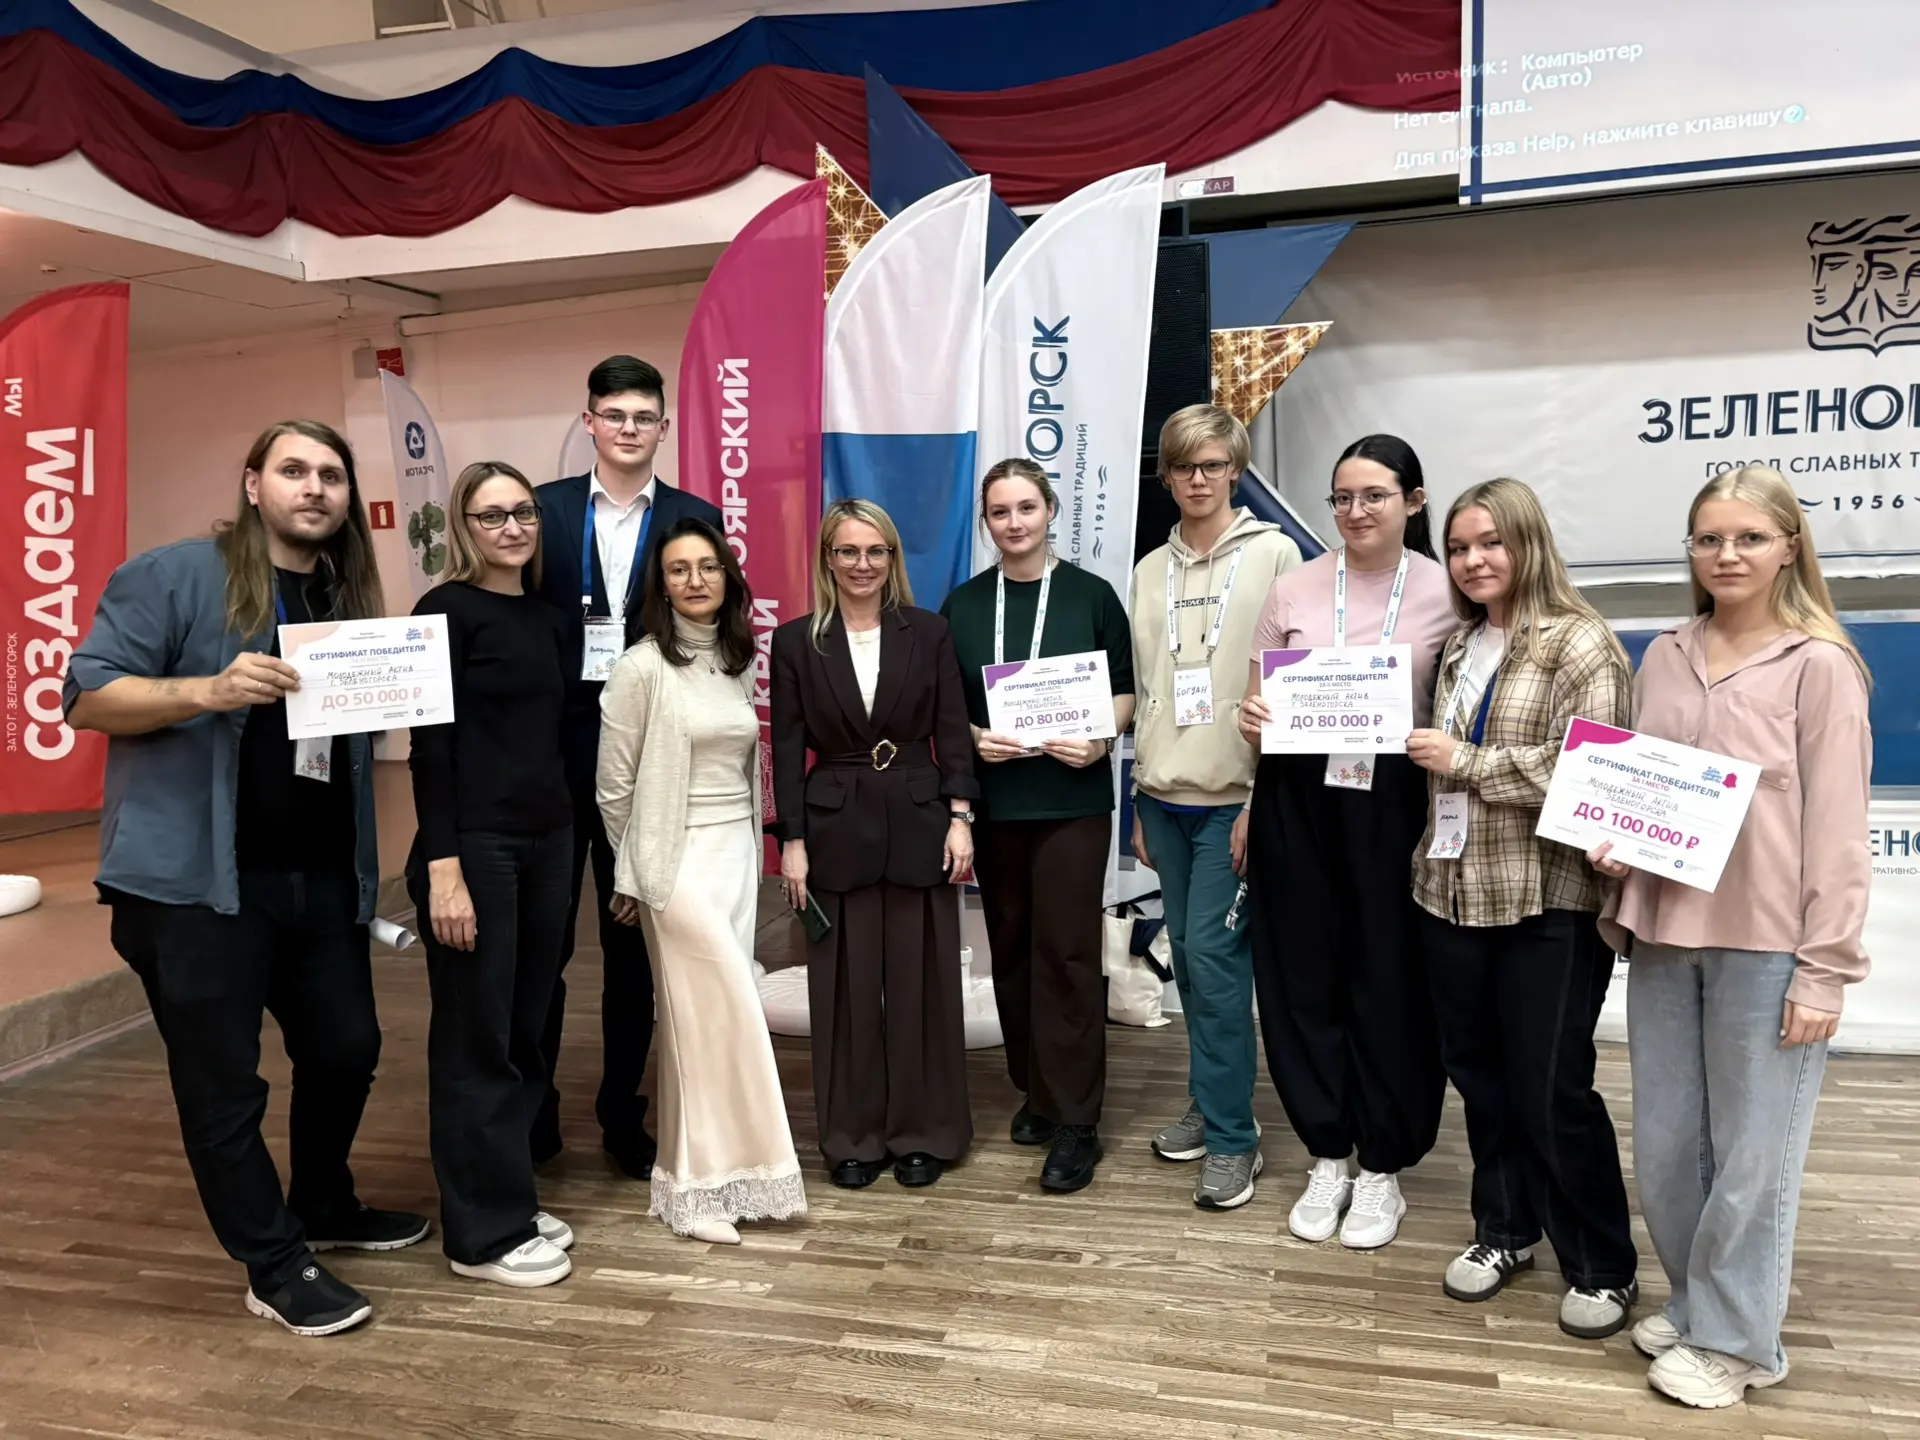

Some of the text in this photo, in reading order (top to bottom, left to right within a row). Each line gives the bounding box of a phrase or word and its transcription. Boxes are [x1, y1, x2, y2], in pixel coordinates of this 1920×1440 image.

[1521, 43, 1644, 71] Компьютер
[1521, 66, 1593, 93] (Авто)
[1394, 112, 1432, 129] Нет
[1394, 150, 1436, 170] Для
[1442, 140, 1516, 163] показа
[1583, 121, 1680, 147] нажмите
[1074, 423, 1088, 492] ТРАДИЦИЙ
[1790, 452, 1902, 473] СЛАВНЫХ
[1071, 494, 1083, 554] СЛАВНЫХ
[309, 644, 426, 661] СЕРТИФИКАТ ПОБЕДИТЕЛЯ
[7, 632, 18, 709] ЗЕЛЕНОГОРСК
[1282, 673, 1389, 683] СЕРТИФИКАТ ПОБЕДИТЕЛЯ
[1004, 675, 1091, 692] СЕРТИФИКАТ ПОБЕДИТЕЛЯ
[321, 693, 349, 711] ДО
[353, 691, 374, 706] 50
[377, 688, 408, 703] 000
[1014, 715, 1034, 729] ДО
[1037, 713, 1053, 725] 80
[1055, 710, 1079, 723] 000
[1290, 715, 1314, 730] ДО
[1318, 715, 1337, 727] 80
[1340, 714, 1369, 727] 000
[7, 722, 17, 752] ЗАТО
[1587, 755, 1652, 779] СЕРТИФИКАТ
[1653, 773, 1721, 799] ПОБЕДИТЕЛЯ
[1644, 779, 1670, 792] МЕСТО
[1572, 802, 1605, 821] ДО
[1611, 812, 1645, 834] 100
[1647, 823, 1683, 846] 000
